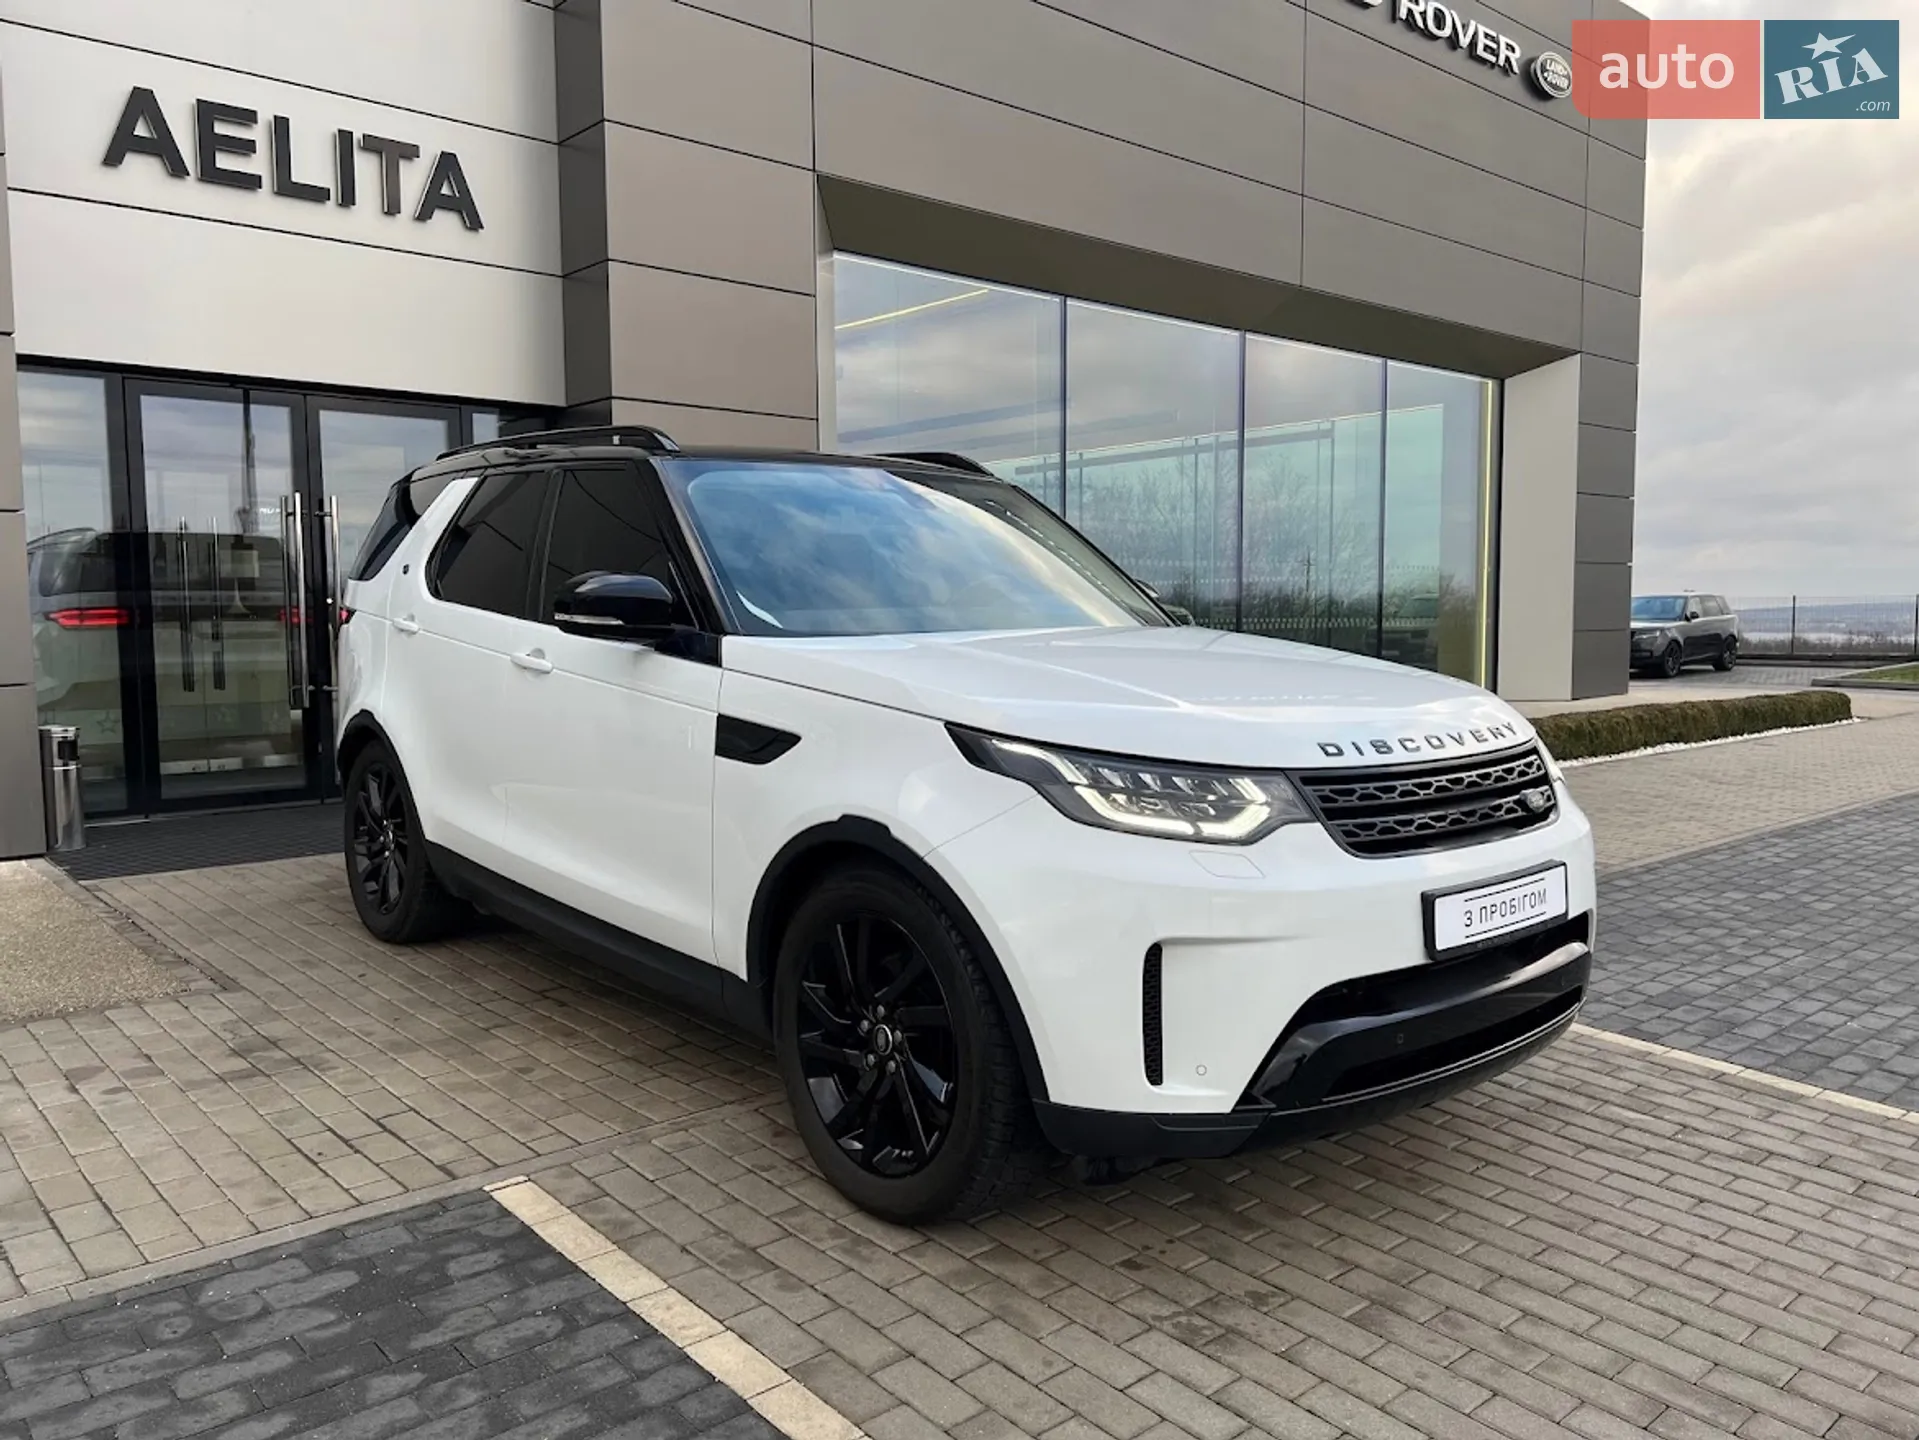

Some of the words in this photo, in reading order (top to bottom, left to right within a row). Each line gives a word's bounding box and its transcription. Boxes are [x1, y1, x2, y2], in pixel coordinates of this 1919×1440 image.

[1397, 0, 1522, 74] ROVER
[103, 85, 484, 231] AELITA
[1317, 722, 1517, 757] DISCOVERY
[1478, 888, 1547, 924] ПРОБІГОМ
